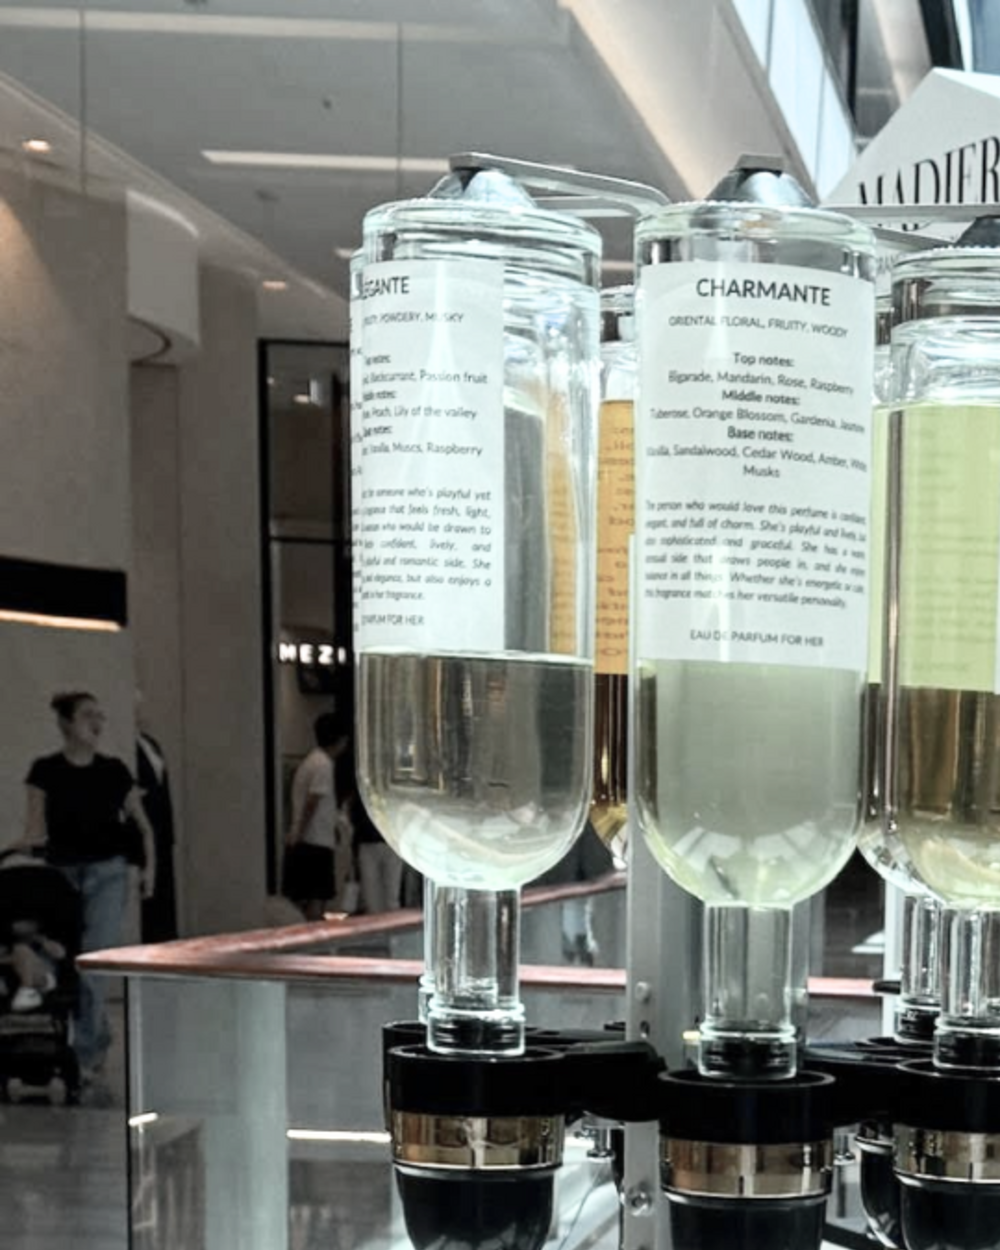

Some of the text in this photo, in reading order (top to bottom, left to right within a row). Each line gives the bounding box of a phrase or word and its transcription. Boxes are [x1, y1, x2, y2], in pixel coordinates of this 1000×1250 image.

[696, 278, 831, 306] CHARMANTE
[425, 310, 464, 322] MSKY
[733, 352, 794, 367] Top notes:
[420, 369, 461, 381] Passion
[463, 371, 488, 384] fruit
[717, 371, 775, 386] Mandarin,
[777, 373, 808, 389] Rose,
[722, 389, 800, 406] Middle notes:
[411, 405, 421, 416] of
[423, 405, 441, 417] the
[444, 406, 478, 420] valley
[693, 406, 733, 422] Orange
[737, 407, 788, 423] Blossom,
[727, 425, 794, 442] Base notes:
[426, 442, 483, 456] Raspberry
[673, 443, 739, 459] Sandalwood,
[742, 445, 777, 461] Cedar
[780, 447, 816, 464] Wood,
[743, 463, 780, 479] Musks
[436, 488, 471, 500] playful
[475, 490, 491, 501] yet
[465, 505, 491, 519] light,
[686, 499, 705, 512] who
[709, 500, 740, 512] would
[743, 501, 765, 514] love
[768, 503, 787, 516] this
[789, 506, 829, 520] perfume
[443, 523, 476, 534] drawn
[480, 525, 491, 536] to
[707, 517, 718, 530] of
[789, 522, 820, 537] playful
[472, 541, 491, 553] and
[801, 540, 818, 553] She
[472, 558, 491, 570] She
[693, 552, 713, 564] that
[757, 557, 791, 571] people
[448, 575, 480, 587] enjoys
[730, 571, 775, 585] Whether
[737, 589, 754, 601] her
[757, 590, 800, 604] versatile
[690, 629, 712, 641] EAU
[731, 630, 778, 644] PARFUM
[781, 633, 802, 646] FOR
[805, 636, 824, 647] HER
